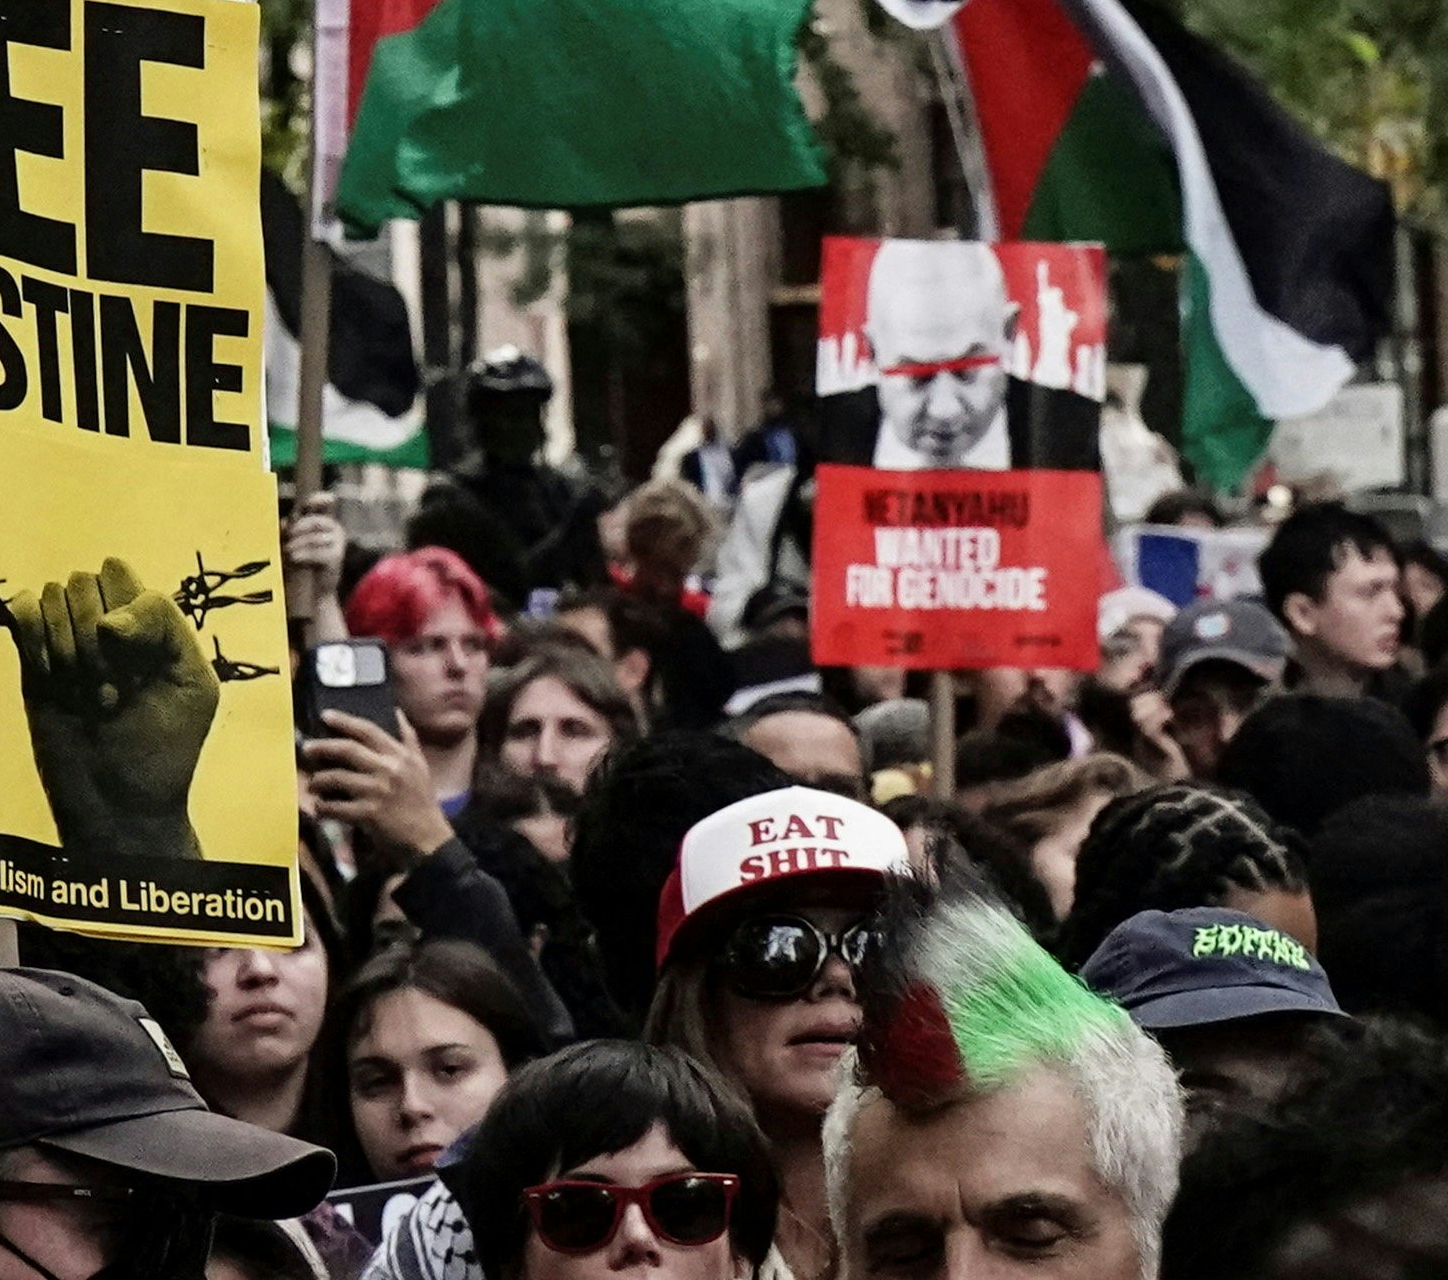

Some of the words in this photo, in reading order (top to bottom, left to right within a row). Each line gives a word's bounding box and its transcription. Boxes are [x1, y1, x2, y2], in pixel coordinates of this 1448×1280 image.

[873, 526, 1001, 570] WANTED
[896, 566, 1049, 611] GENOCIDE
[747, 814, 845, 847] EAT
[739, 847, 849, 886] SHIT
[51, 877, 109, 909] and
[119, 879, 285, 923] Liberation
